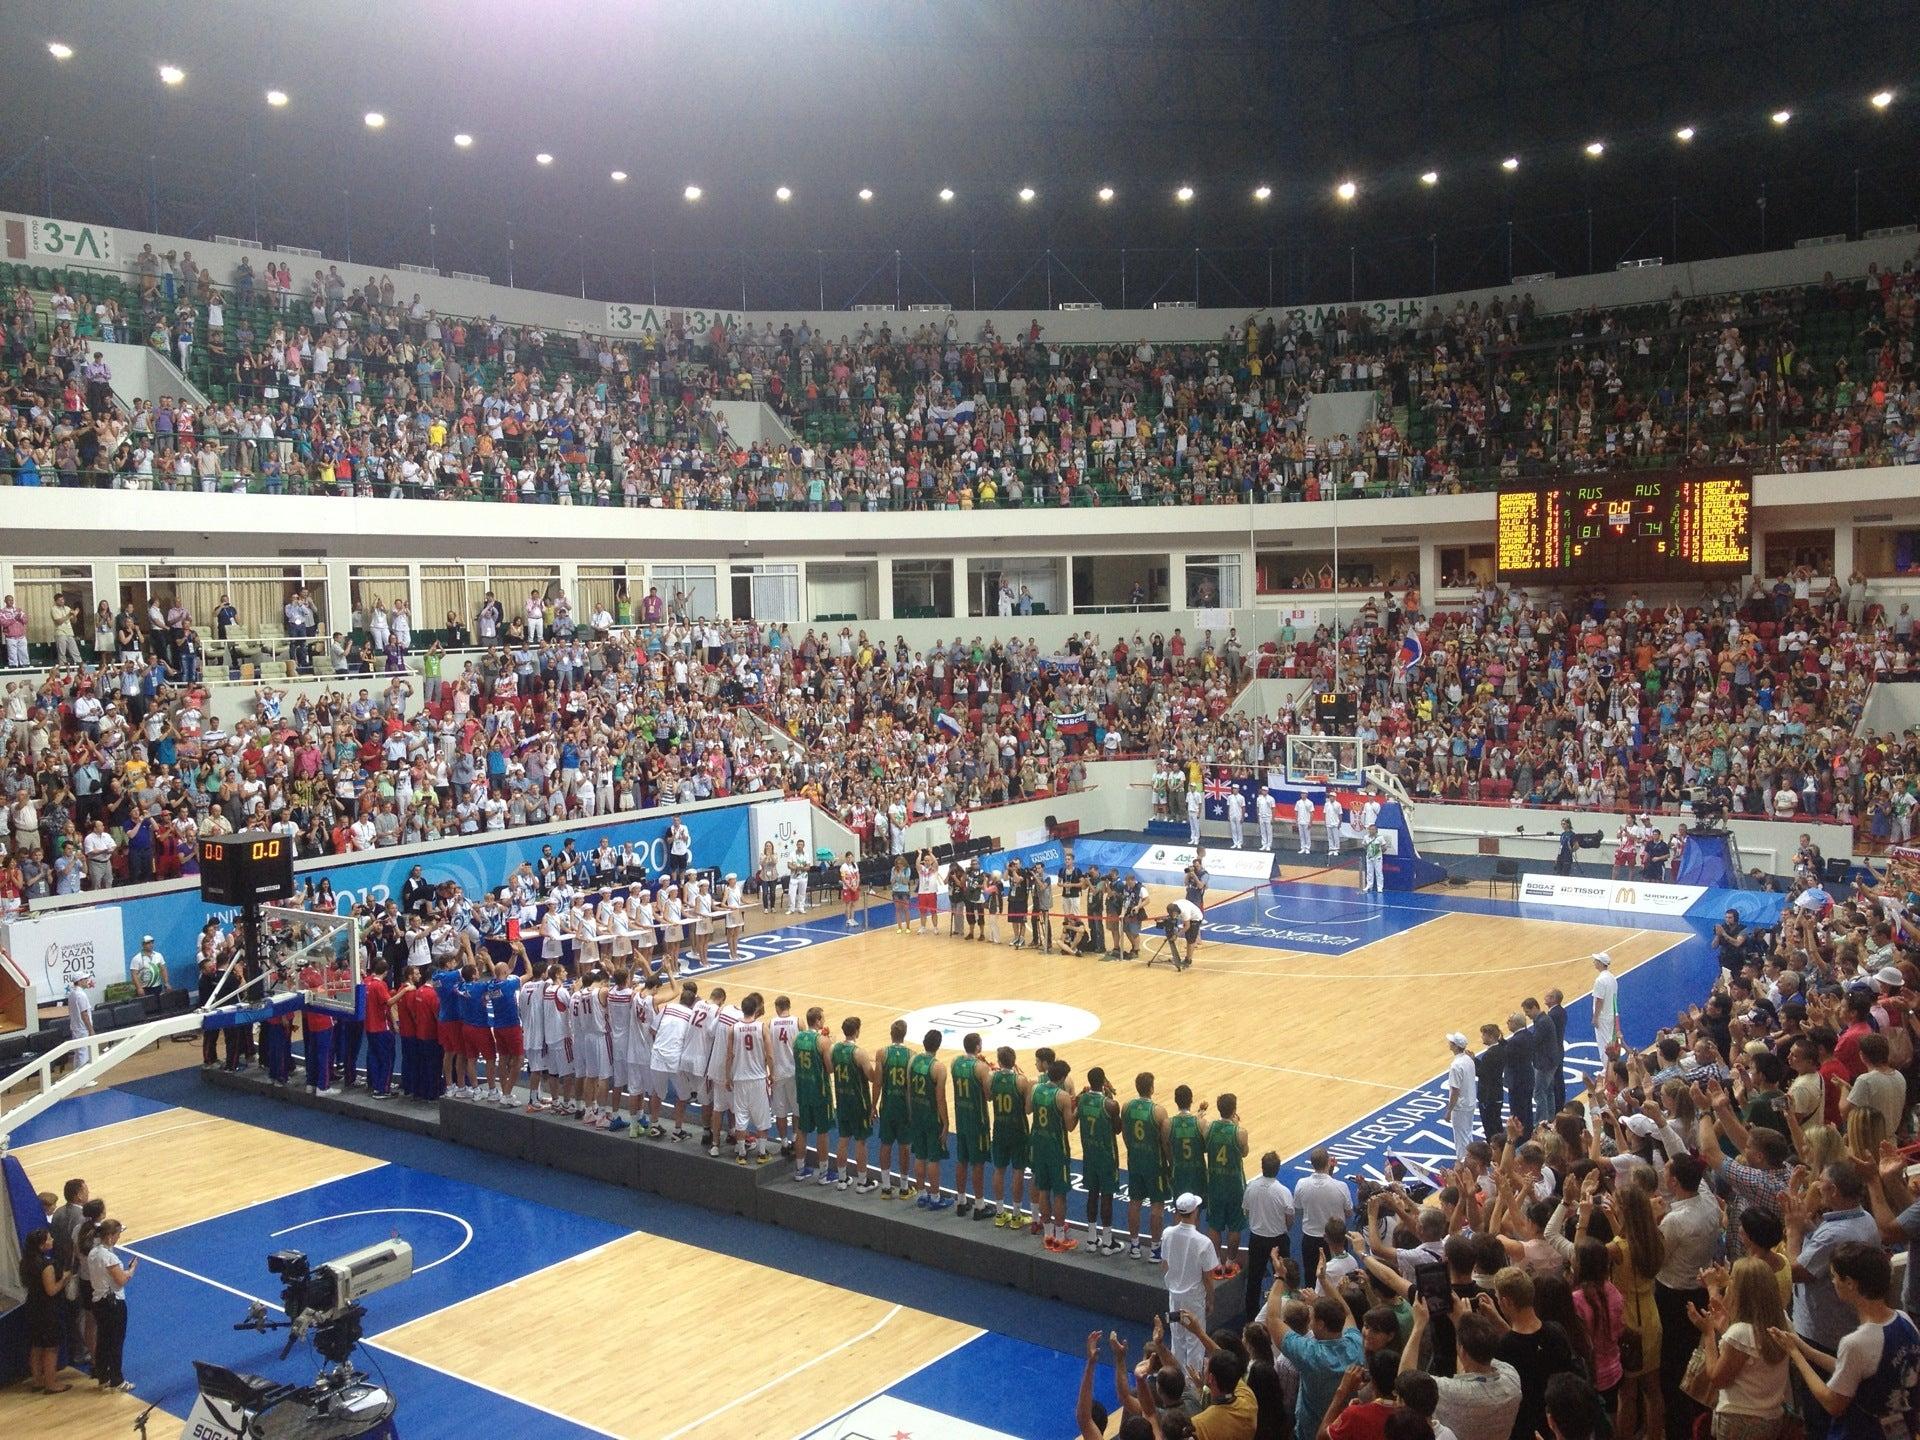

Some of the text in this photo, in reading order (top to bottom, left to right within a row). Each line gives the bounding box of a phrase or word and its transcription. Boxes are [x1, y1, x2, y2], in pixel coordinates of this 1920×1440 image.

[1579, 487, 1603, 499] RUS
[1636, 484, 1661, 496] AUS
[1616, 525, 1623, 534] 4
[1646, 522, 1661, 534] 74
[1574, 545, 1582, 556] 5
[1658, 541, 1666, 552] 5
[205, 843, 223, 861] 0.0
[252, 840, 280, 860] 0.0
[1574, 887, 1605, 896] TISSOT
[61, 946, 94, 960] KAZAN
[62, 955, 95, 974] 2013
[691, 1009, 708, 1028] 12
[745, 1034, 754, 1051] 9
[779, 1027, 788, 1044] 4
[799, 1051, 811, 1070] 15
[835, 1064, 849, 1083] 14
[889, 1067, 906, 1087] 13
[911, 1076, 926, 1096] 12
[956, 1077, 970, 1099] 11
[995, 1093, 1013, 1114] 10
[1039, 1106, 1049, 1128] 8
[1087, 1116, 1097, 1136] 7
[1134, 1120, 1145, 1141] 6
[1182, 1138, 1192, 1160] 5
[1215, 1144, 1228, 1167] 4
[193, 1423, 229, 1440] SOG
